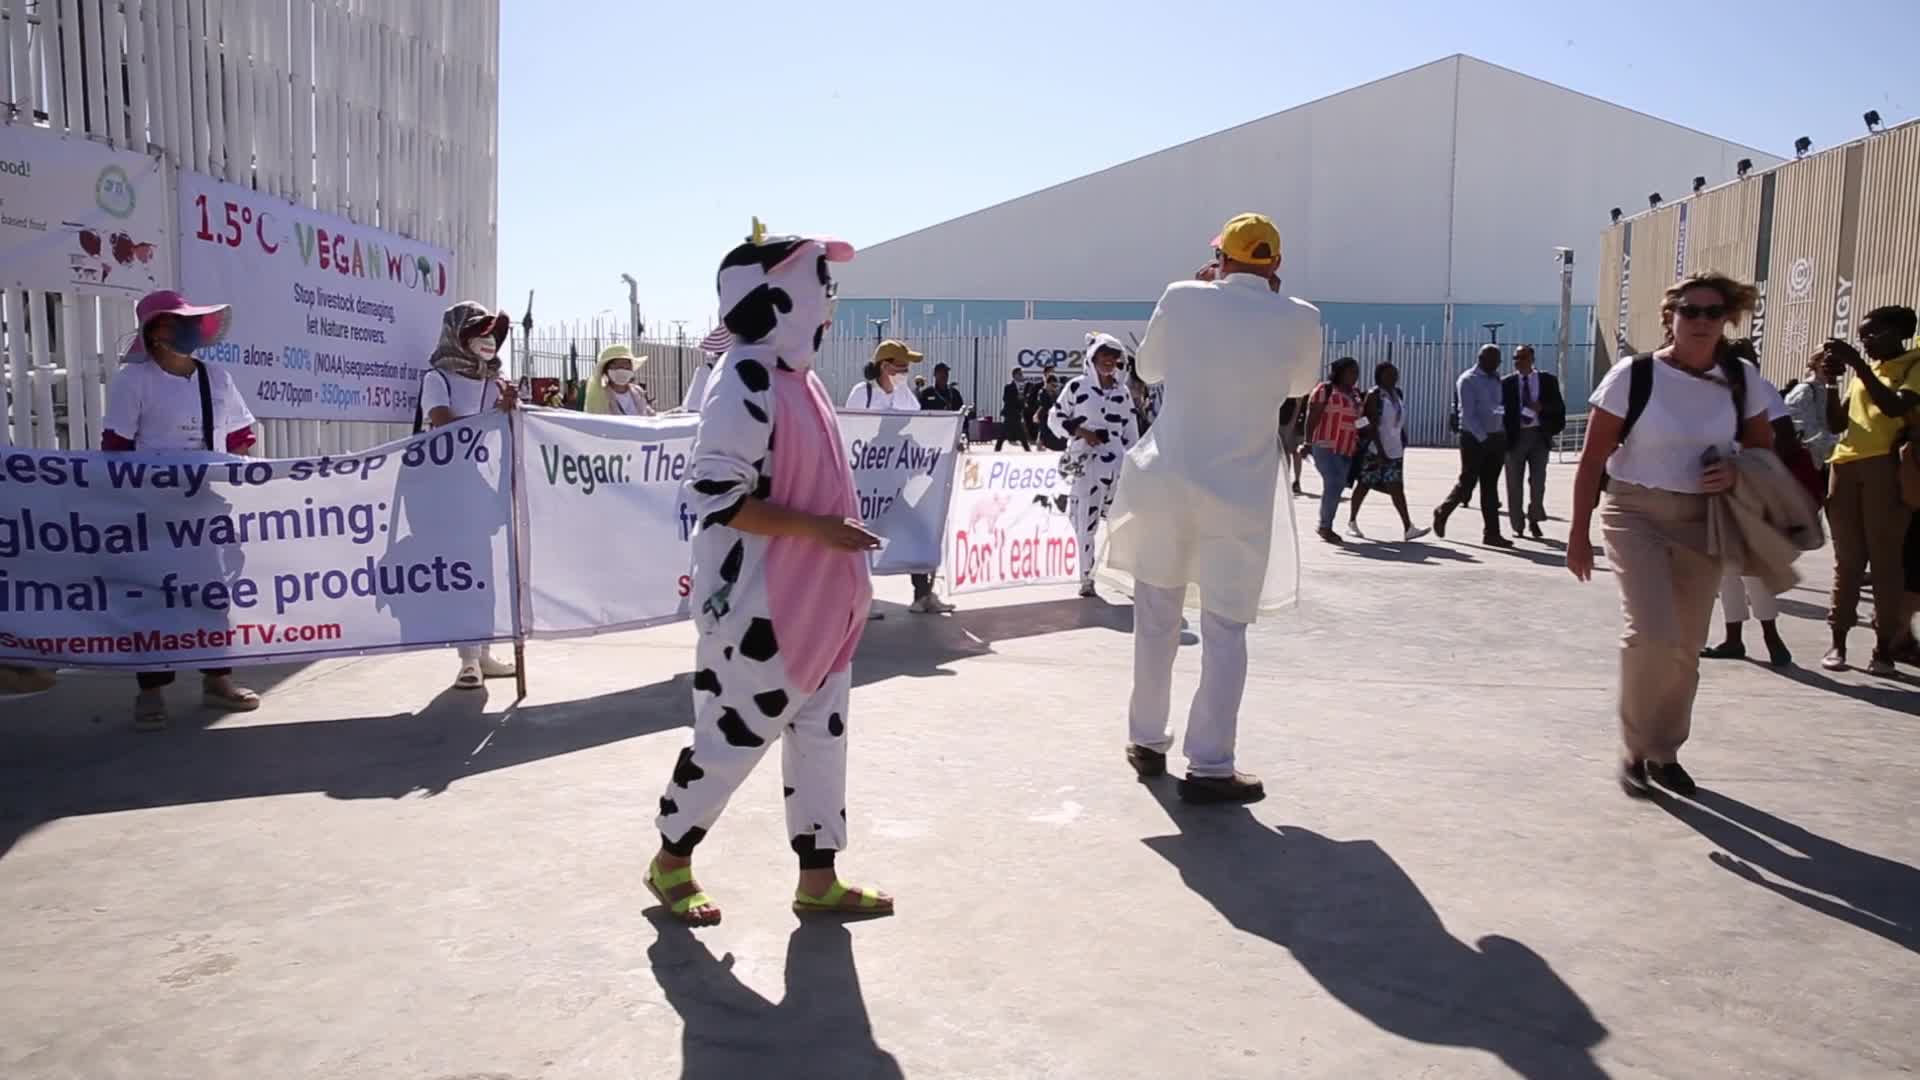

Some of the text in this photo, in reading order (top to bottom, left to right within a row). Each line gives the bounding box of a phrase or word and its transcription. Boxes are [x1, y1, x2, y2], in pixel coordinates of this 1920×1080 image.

[195, 195, 279, 254] 1.5°C
[295, 221, 381, 276] VEGAN
[294, 282, 315, 311] Stop
[317, 287, 355, 313] livestock
[306, 313, 387, 344] let Nature recovers.
[243, 344, 274, 367] alone
[1017, 349, 1086, 368] COP2
[257, 381, 313, 408] 420-70ppm
[0, 426, 490, 497] est way to stop 80%
[540, 443, 686, 495] Vegan: The
[849, 439, 942, 476] Steer Away
[988, 461, 1057, 490] Please
[856, 487, 901, 521] pira
[0, 498, 388, 558] global warming:
[955, 525, 1077, 587] Don't eat me
[161, 573, 259, 610] free
[274, 556, 486, 615] products.
[0, 622, 342, 655] SupremeMasterTV.com
